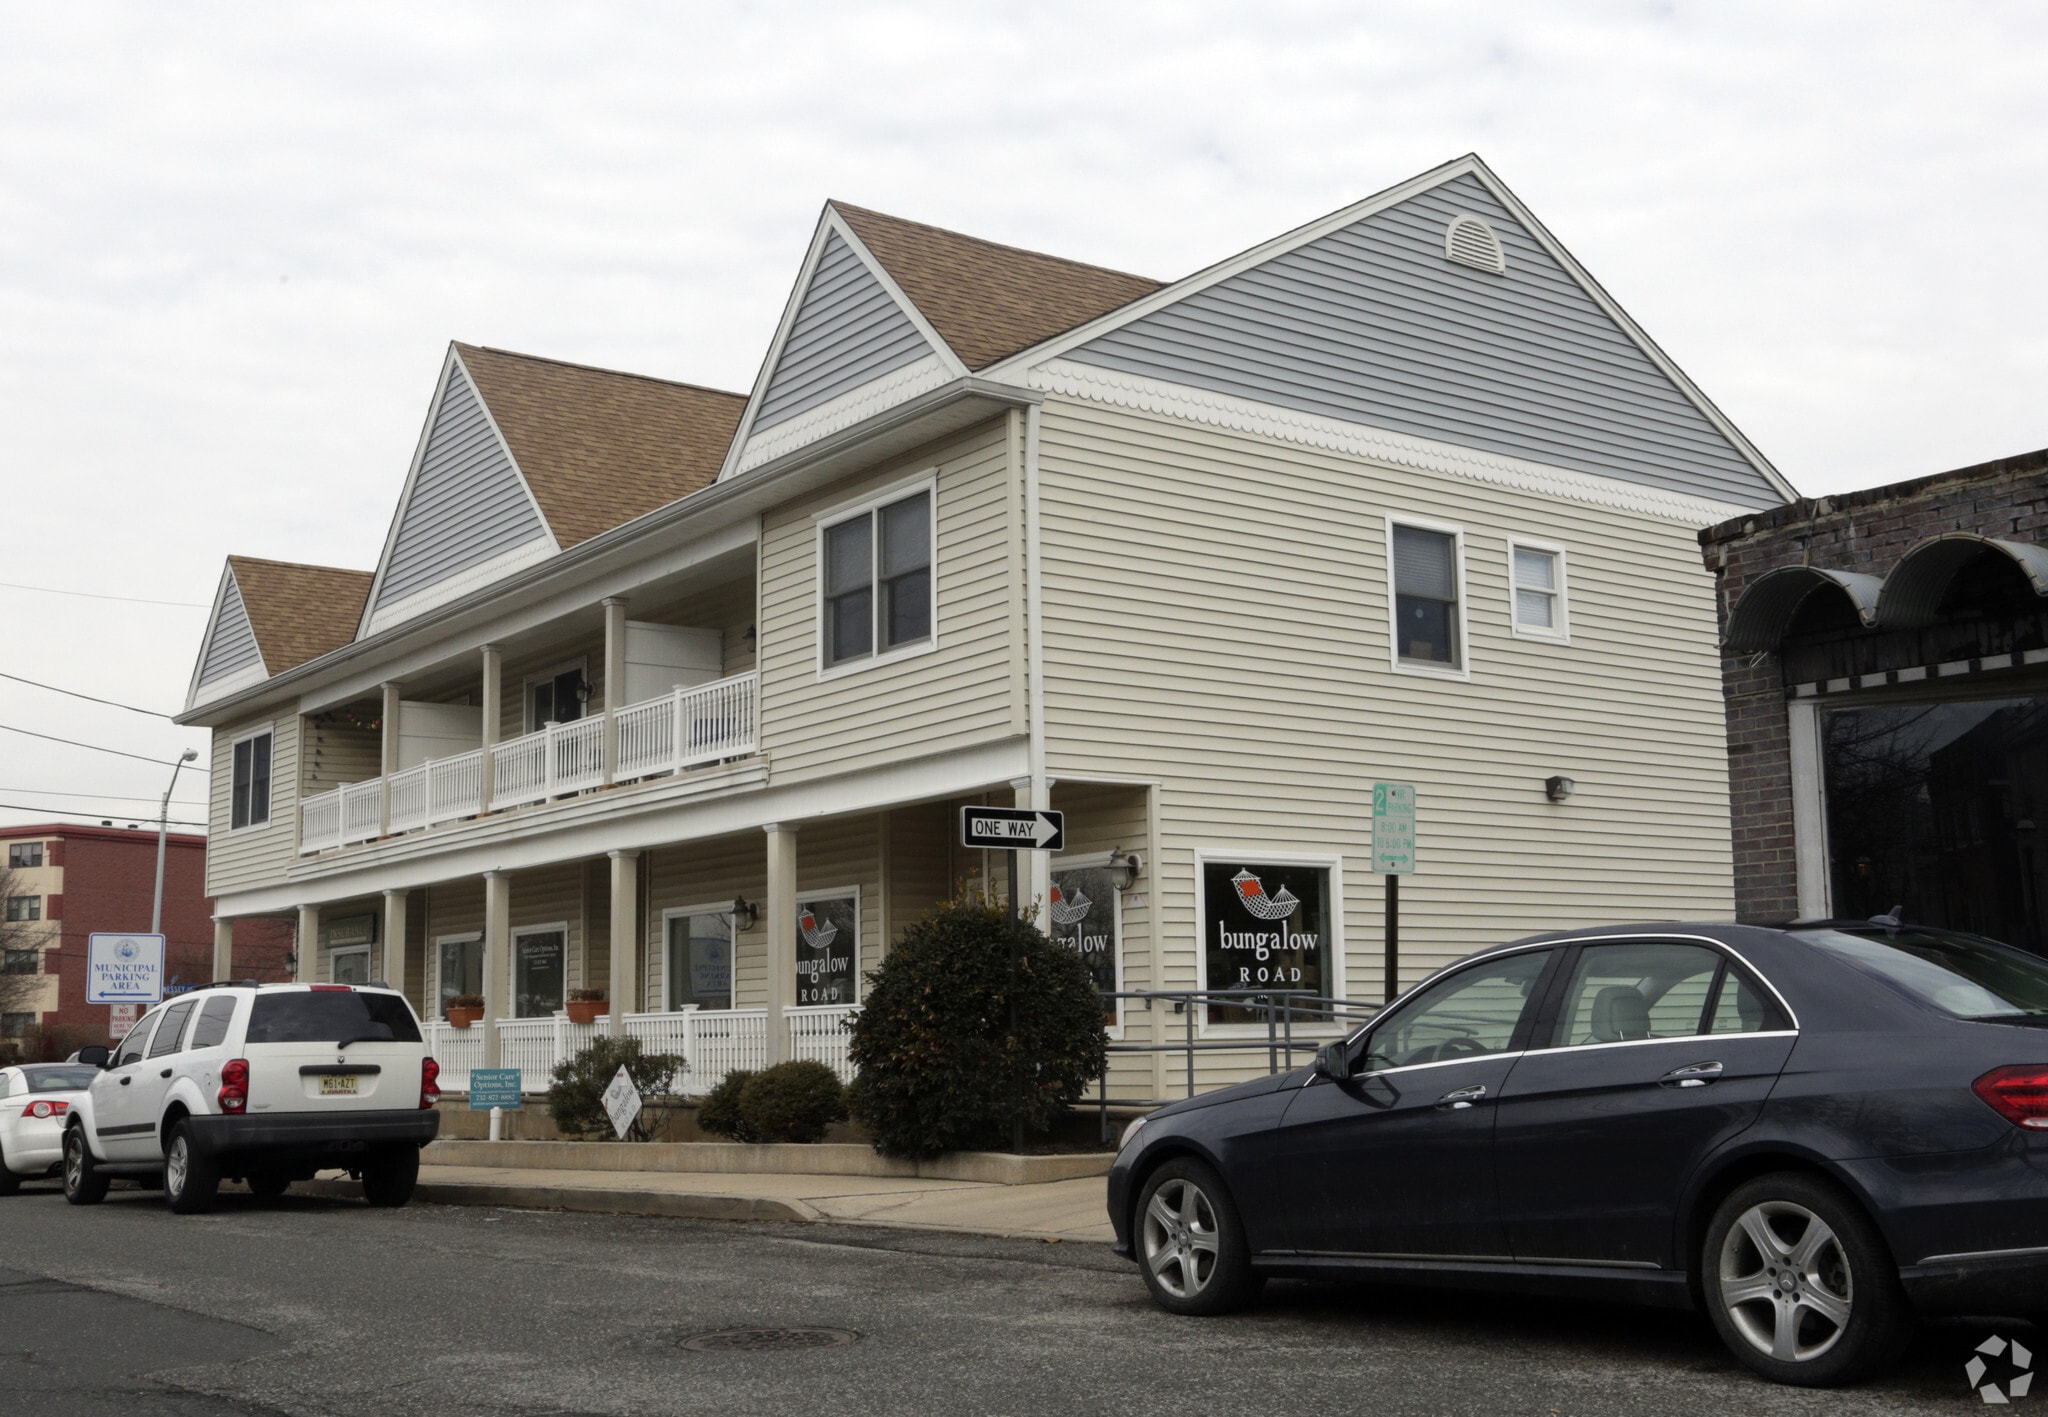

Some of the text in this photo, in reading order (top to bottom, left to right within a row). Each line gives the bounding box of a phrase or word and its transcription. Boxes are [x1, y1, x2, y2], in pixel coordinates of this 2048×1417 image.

[1375, 789, 1385, 812] 2
[1388, 802, 1412, 814] PARKING
[975, 819, 1035, 838] ONE WAY
[1381, 822, 1408, 833] 8:00 AM
[1385, 837, 1401, 849] 6:00
[1403, 838, 1413, 849] PM
[1219, 919, 1318, 961] bungalow
[95, 964, 158, 973] MUNICIPAL
[1240, 966, 1302, 982] ROAD
[102, 973, 150, 981] PARKING
[110, 982, 140, 990] AREA
[801, 987, 839, 1003] ROAD
[119, 1007, 129, 1015] NO
[476, 1072, 516, 1081] Senior Care
[473, 1080, 517, 1090] Options, Inc.
[609, 1085, 634, 1125] bungalow
